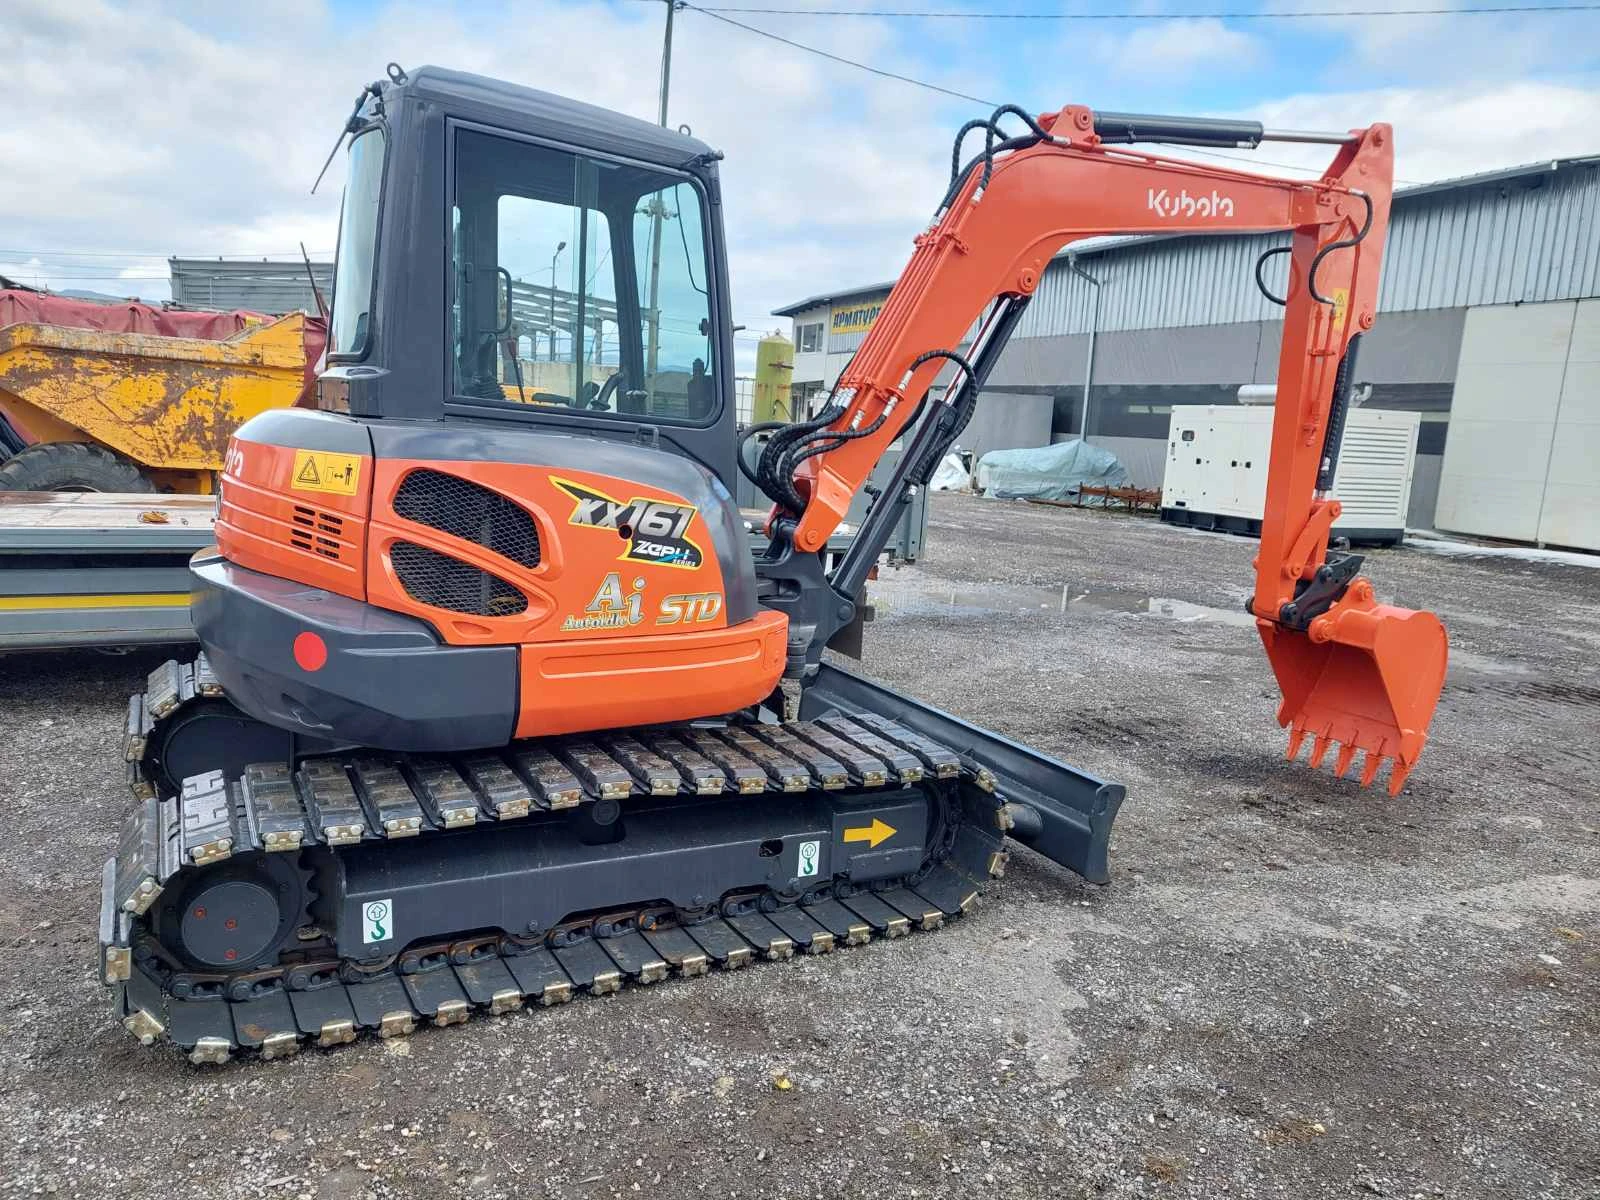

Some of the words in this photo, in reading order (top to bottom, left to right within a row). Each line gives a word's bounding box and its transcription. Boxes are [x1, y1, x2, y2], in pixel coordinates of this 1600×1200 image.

[1148, 188, 1234, 217] Kubota
[573, 498, 694, 538] KX161
[586, 573, 646, 624] Ai
[656, 593, 722, 625] STD
